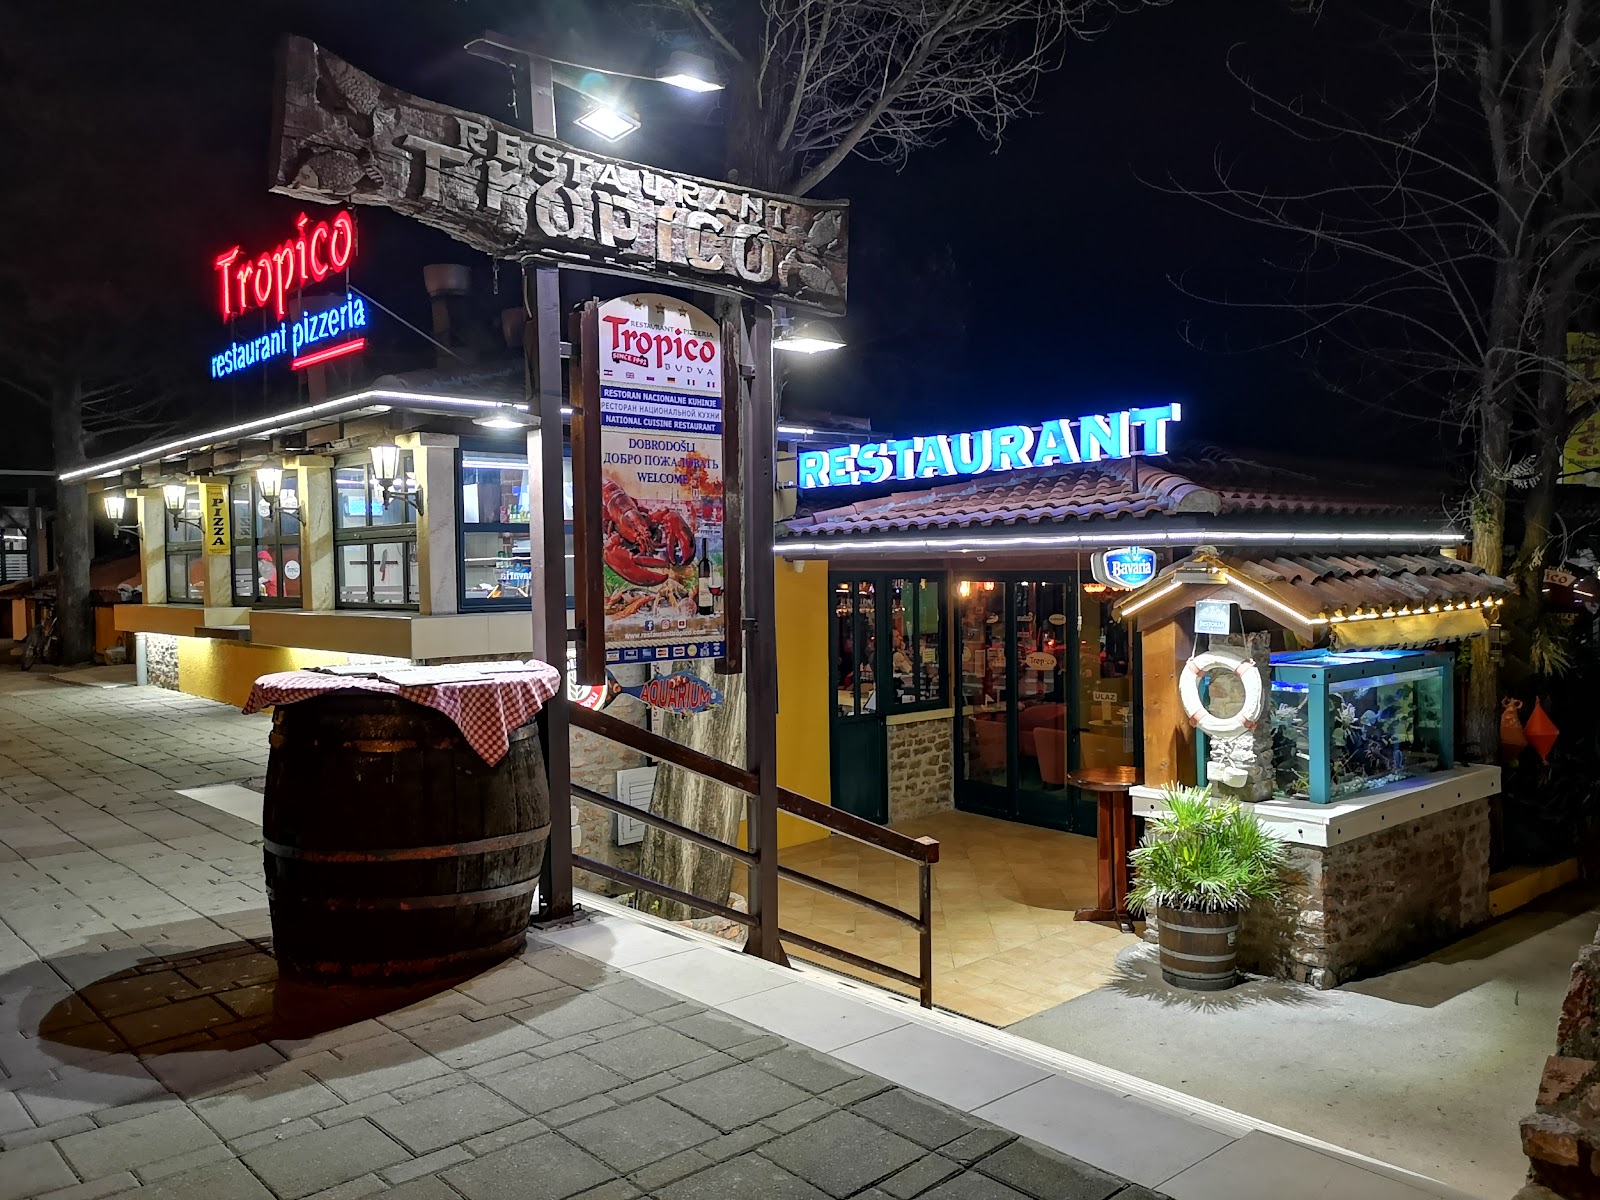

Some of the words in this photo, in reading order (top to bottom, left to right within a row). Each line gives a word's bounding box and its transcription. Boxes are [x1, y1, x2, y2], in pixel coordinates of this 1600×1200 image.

[457, 116, 791, 230] RESTAURANT
[214, 211, 353, 324] Tropico
[211, 323, 287, 379] restaurant
[292, 293, 366, 357] pizzeria
[630, 320, 675, 333] RESTAURANT
[683, 328, 715, 339] PIZZERIA
[602, 315, 716, 368] Tropico
[612, 352, 632, 362] SINCE
[664, 363, 714, 376] BUDVA
[603, 388, 642, 401] RESTORAN
[642, 391, 687, 404] NACIONALNE
[688, 396, 717, 408] KUHINJE
[601, 401, 638, 412] РЕСТОРАН
[639, 406, 697, 418] НАЦИОНАЛЬНОЙ
[698, 412, 720, 420] КУХНИ
[605, 414, 643, 425] NATIONAL
[643, 418, 673, 429] CUISINE
[673, 421, 716, 432] RESTAURANT
[628, 438, 695, 453] DOBRODOŠLI
[799, 402, 1182, 489] RESTAURANT
[603, 452, 642, 465] ДОБРО
[644, 454, 719, 470] ПОЖАЛОВАТЬ
[637, 472, 689, 485] WELCOME
[211, 498, 226, 545] PIZZA
[1112, 559, 1152, 577] Bavaria
[639, 680, 711, 709] AQUARIUM
[1094, 693, 1116, 701] ULAZ
